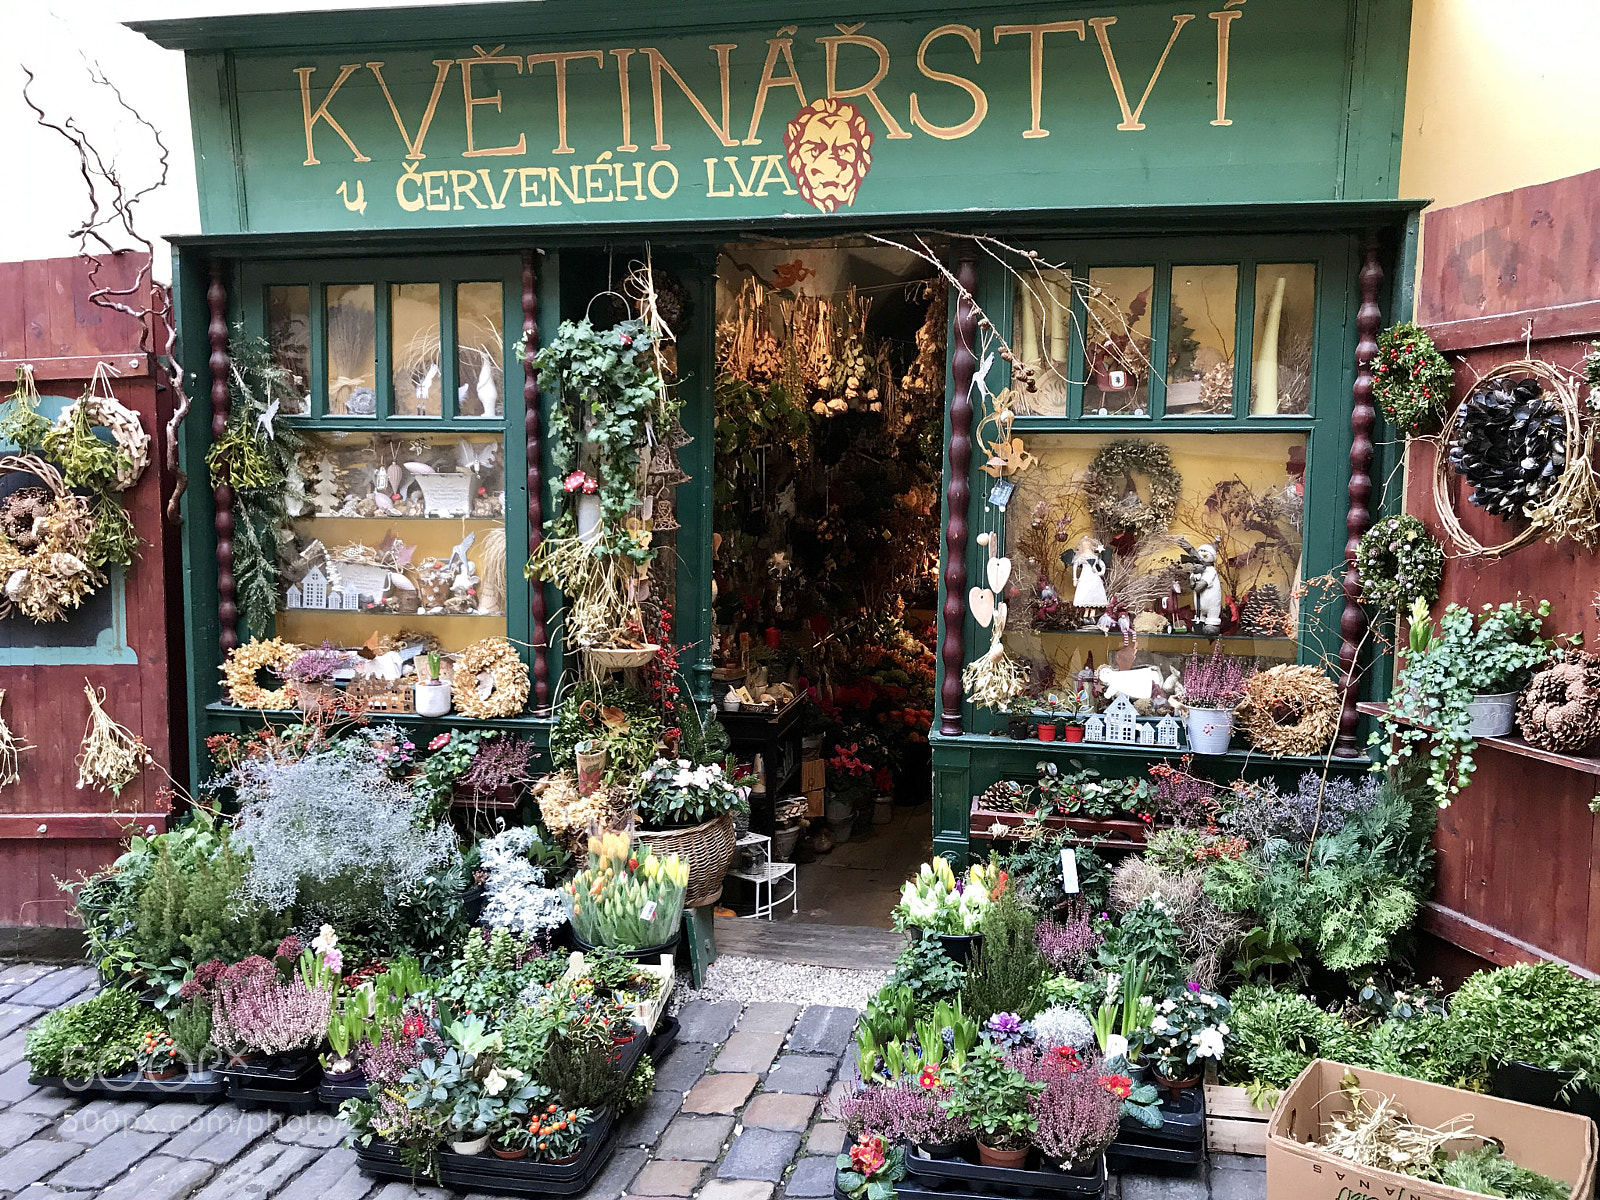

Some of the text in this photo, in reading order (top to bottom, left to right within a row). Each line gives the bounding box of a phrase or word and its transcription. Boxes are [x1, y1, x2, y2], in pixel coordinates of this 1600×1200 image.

[293, 0, 1246, 166] KVĚTINÁŘSTVÍ
[396, 150, 679, 212] ČERVENÉHO
[703, 154, 799, 198] LVA
